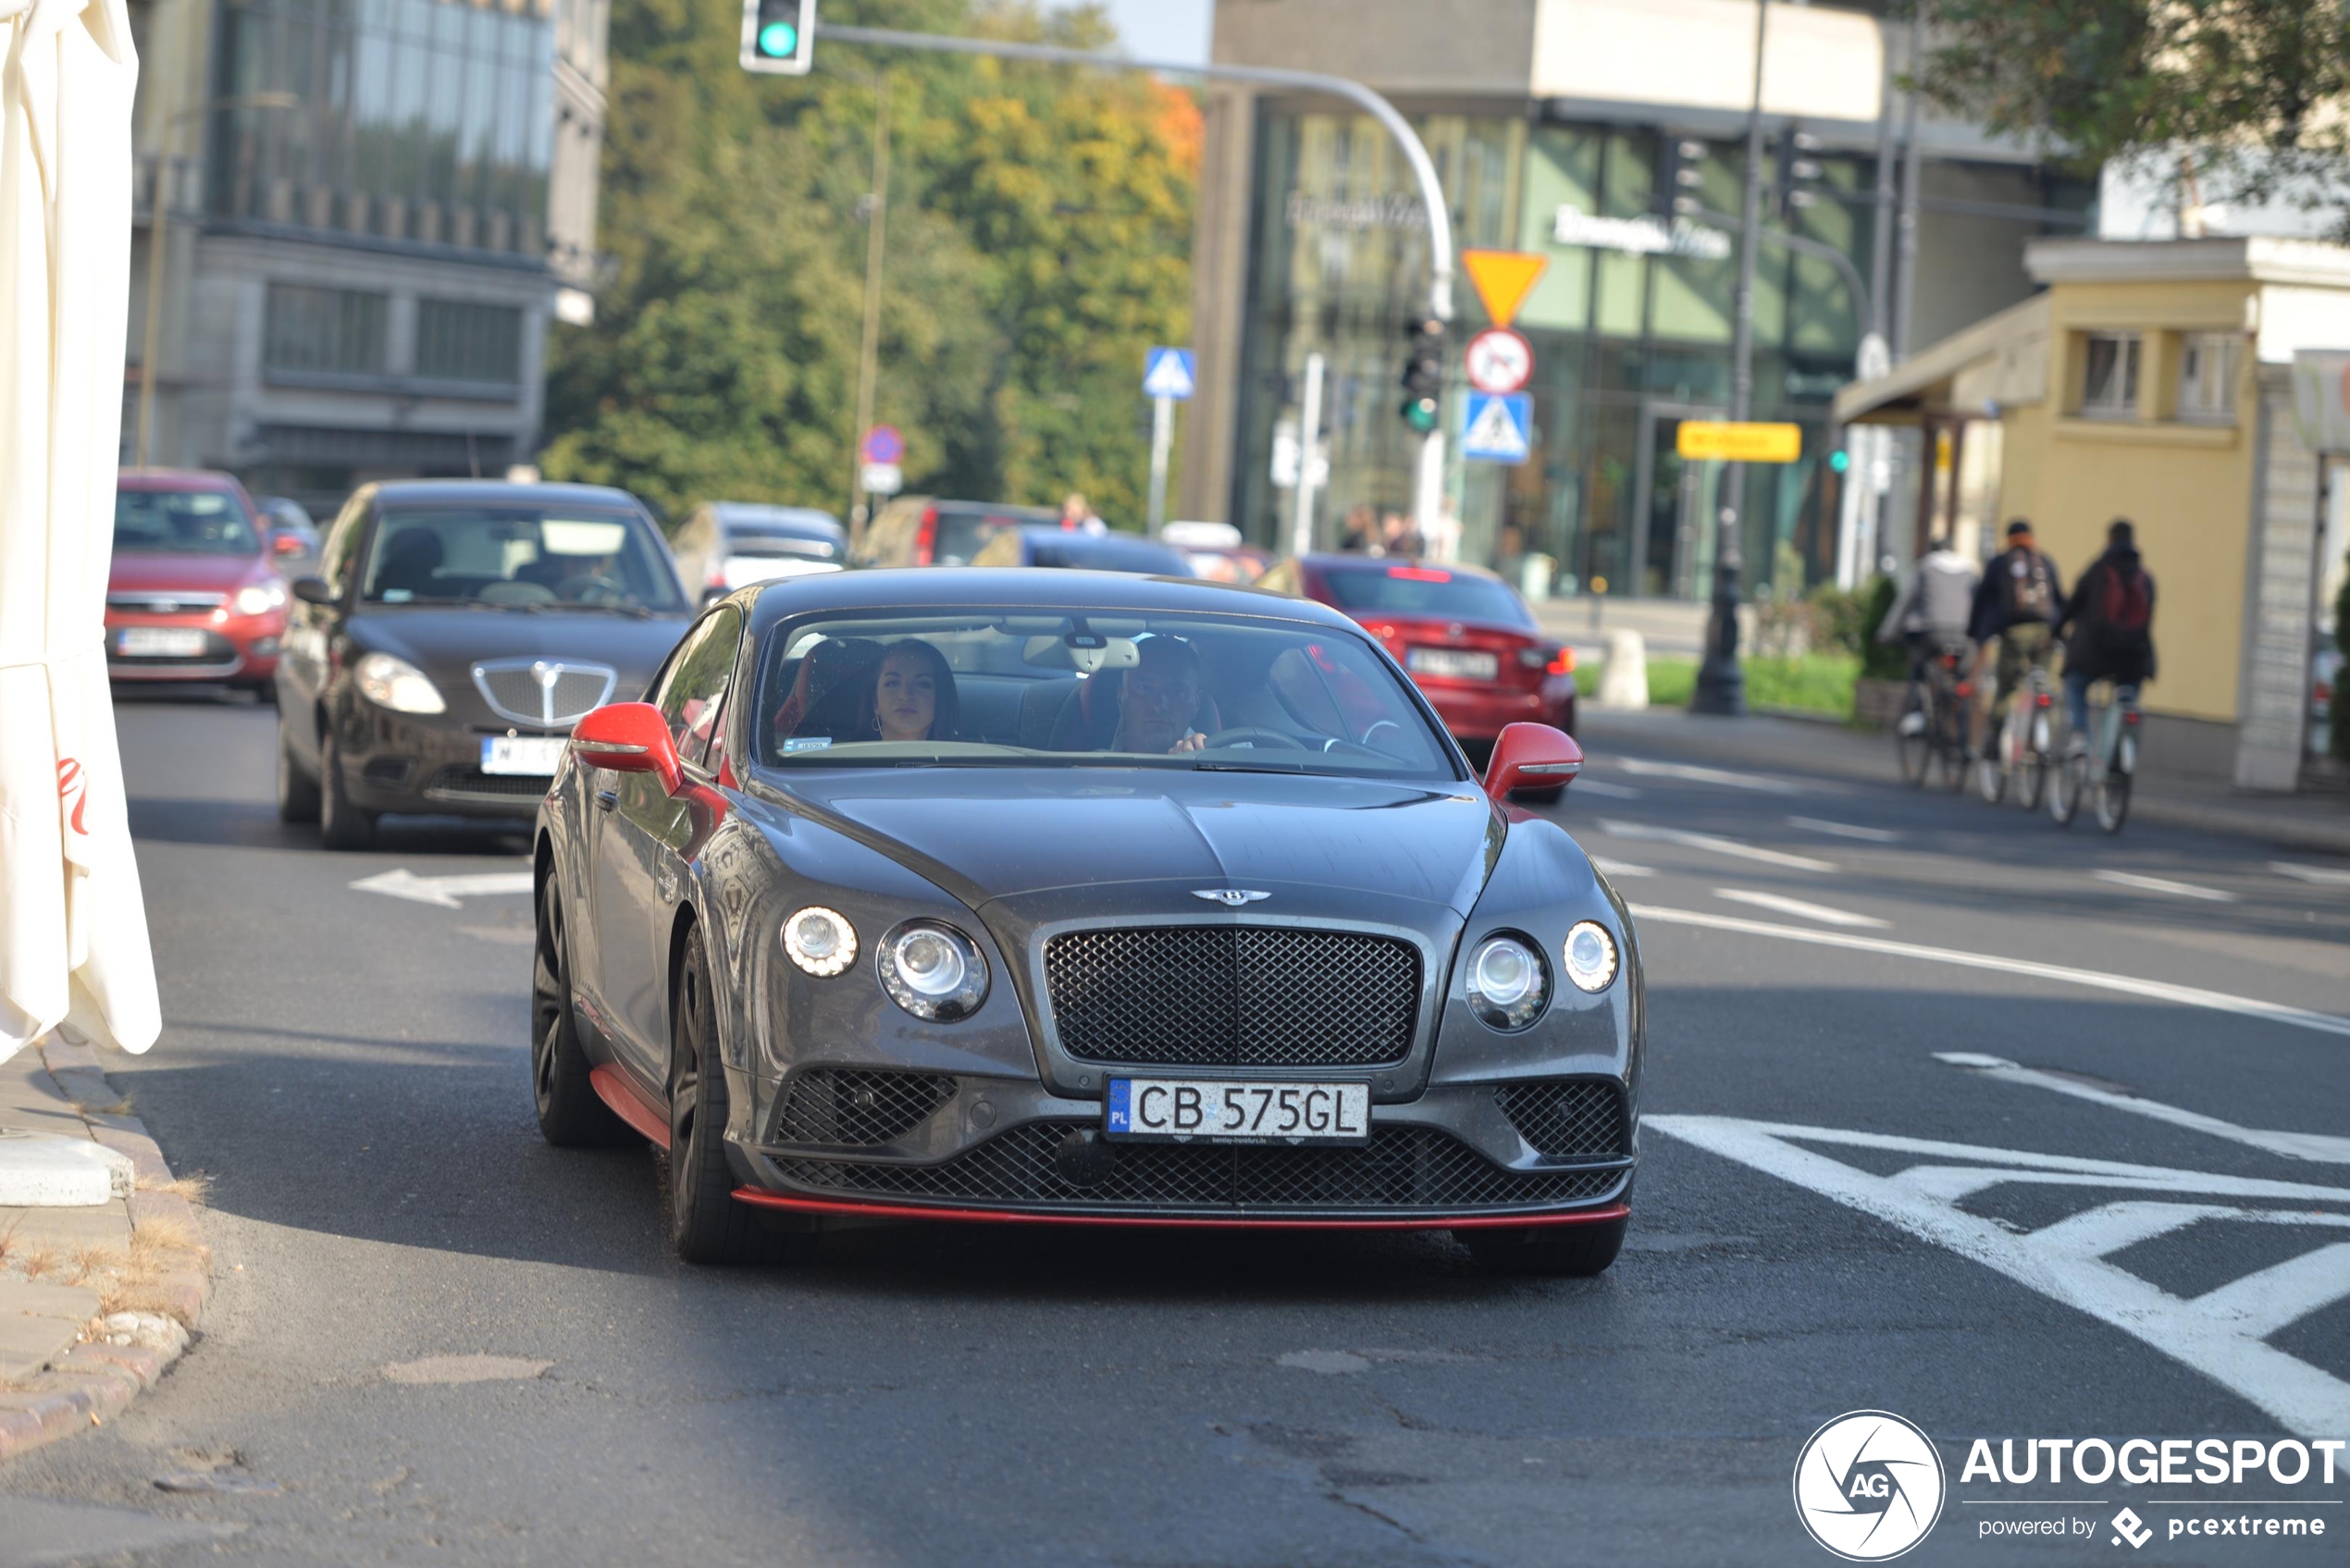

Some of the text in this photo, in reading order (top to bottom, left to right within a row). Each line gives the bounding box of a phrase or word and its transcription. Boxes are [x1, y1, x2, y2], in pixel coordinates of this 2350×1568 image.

[1112, 1111, 1128, 1124] PL
[1139, 1086, 1357, 1133] CB 575GL
